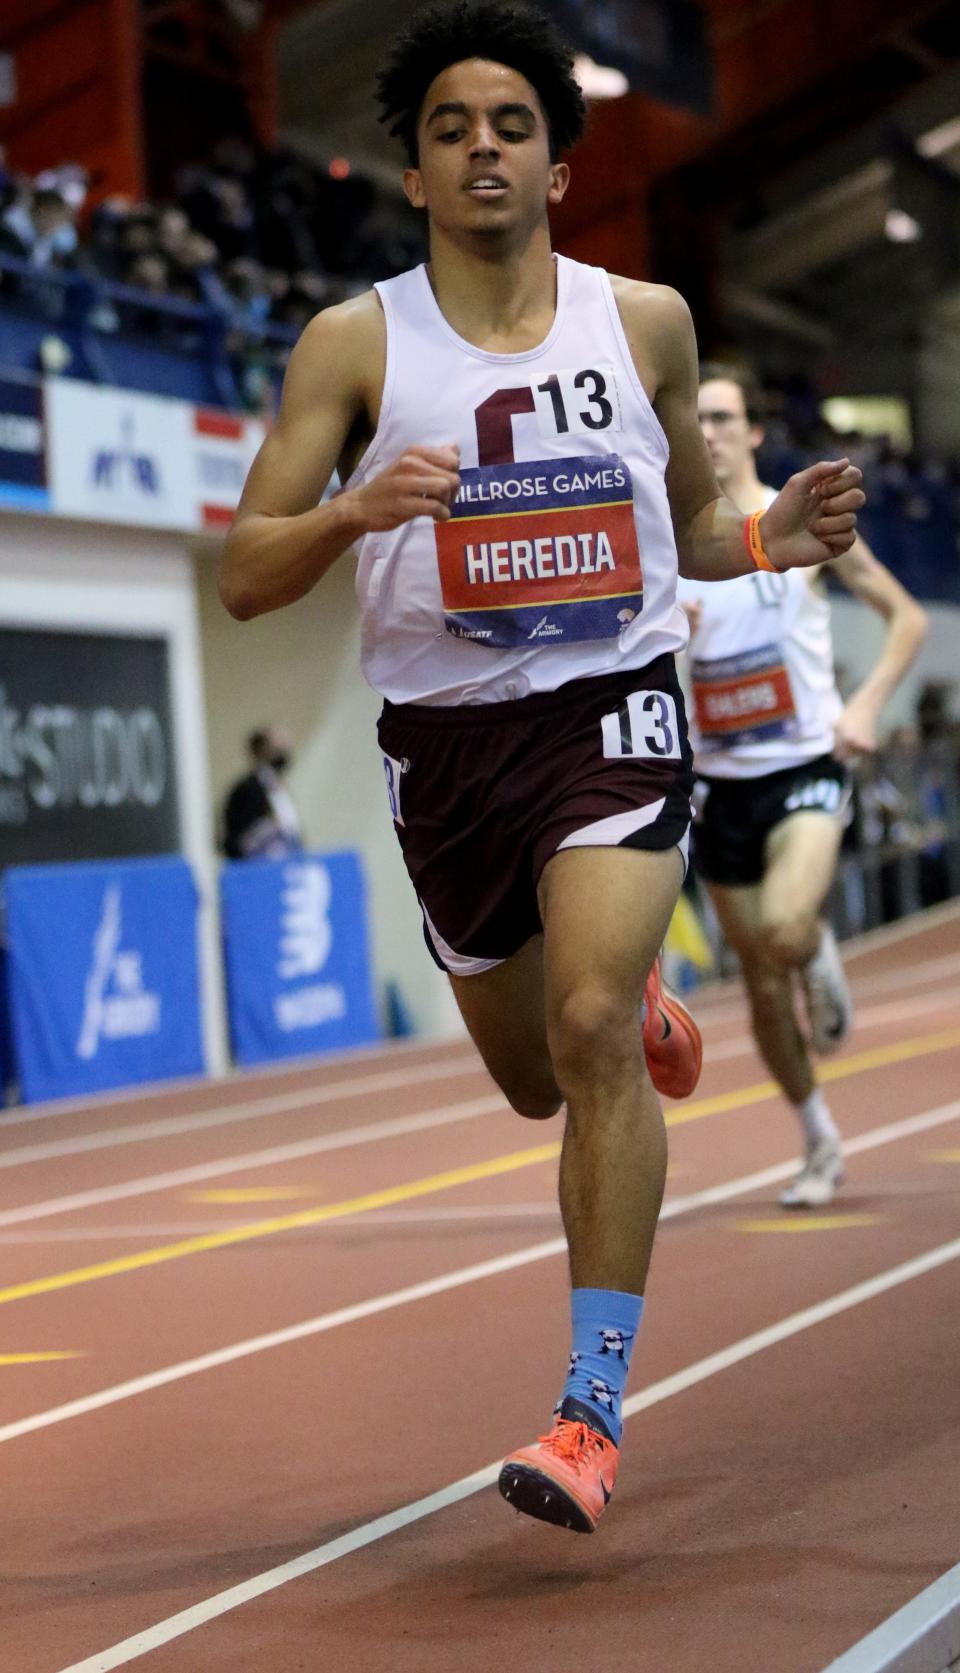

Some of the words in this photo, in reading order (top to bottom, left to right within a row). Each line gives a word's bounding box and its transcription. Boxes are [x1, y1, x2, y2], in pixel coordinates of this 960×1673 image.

[537, 369, 613, 434] 13
[552, 468, 626, 493] GAMES
[465, 531, 616, 585] HEREDIA
[618, 694, 674, 755] 13
